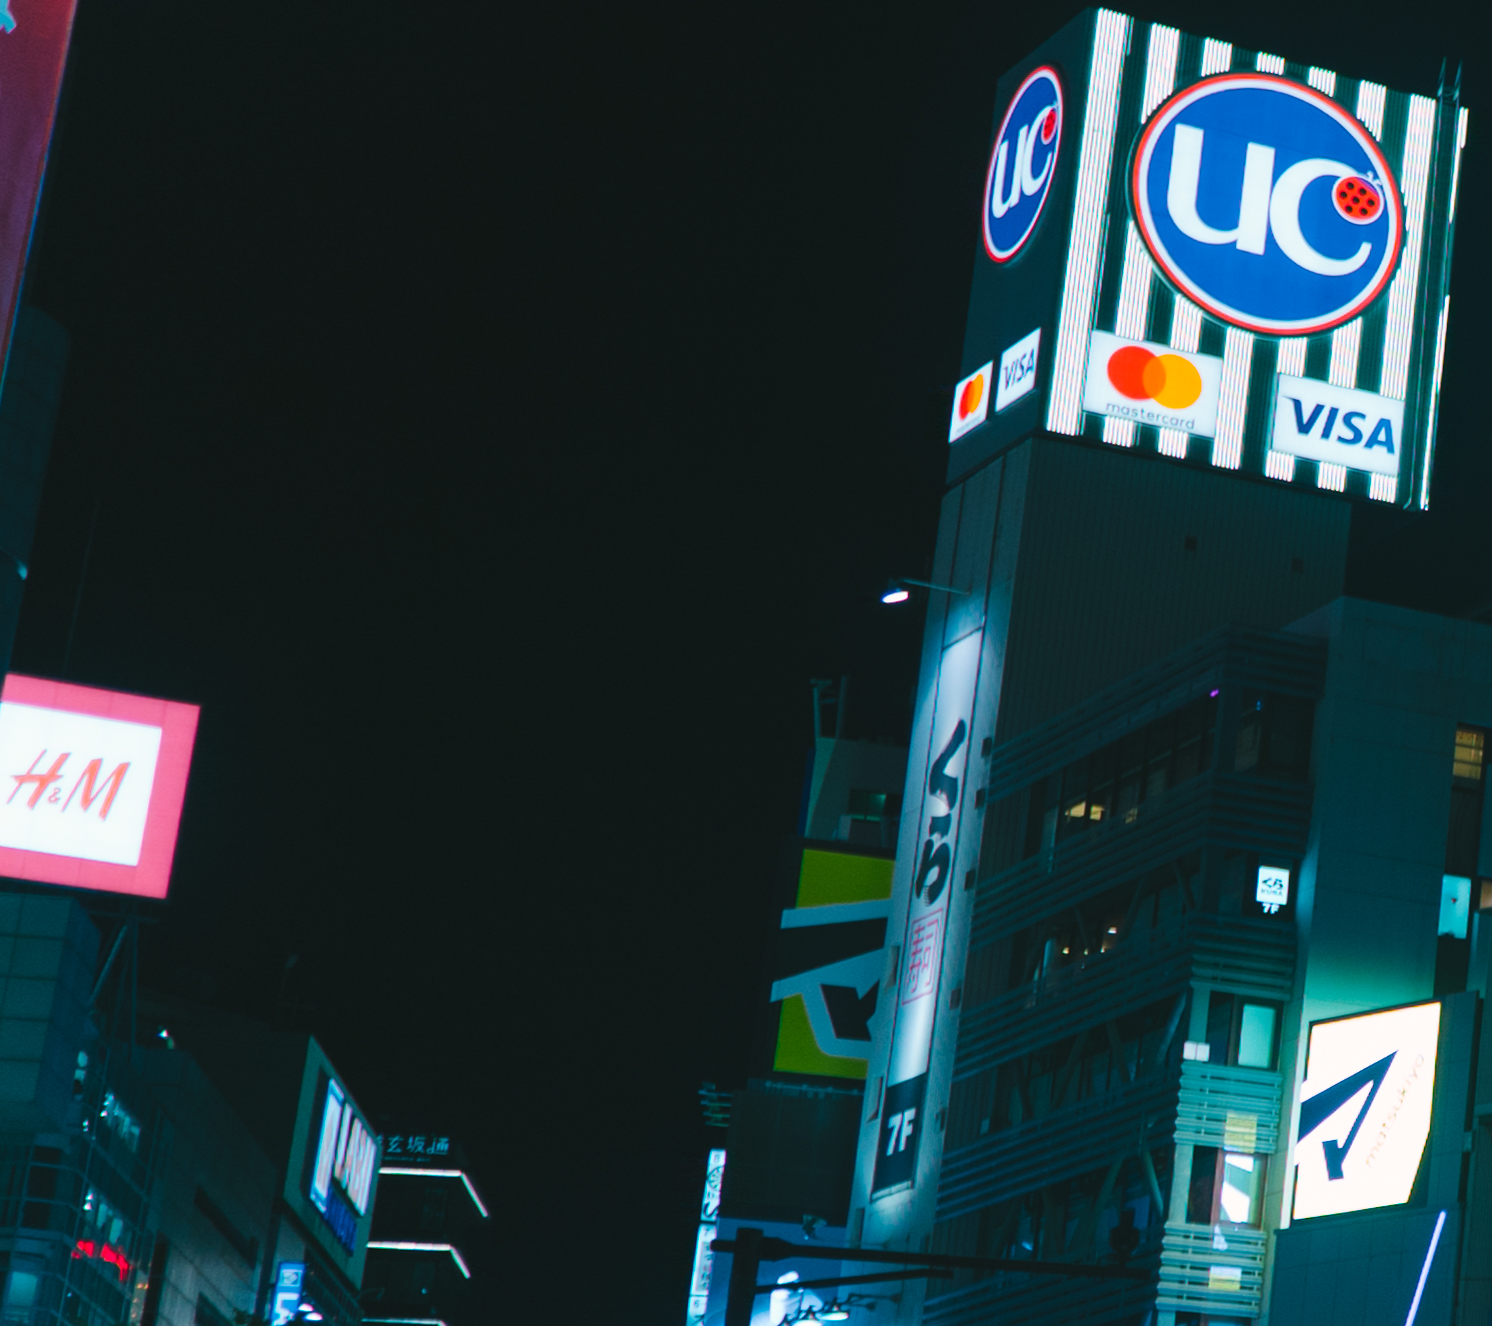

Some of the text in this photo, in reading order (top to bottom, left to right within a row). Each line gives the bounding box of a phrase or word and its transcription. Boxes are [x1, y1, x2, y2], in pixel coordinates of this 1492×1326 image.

[1106, 401, 1196, 431] mastercard
[1283, 395, 1397, 456] VISA
[7, 749, 131, 821] H&M
[377, 1134, 450, 1156] 玄坂通
[887, 1108, 916, 1155] 7F
